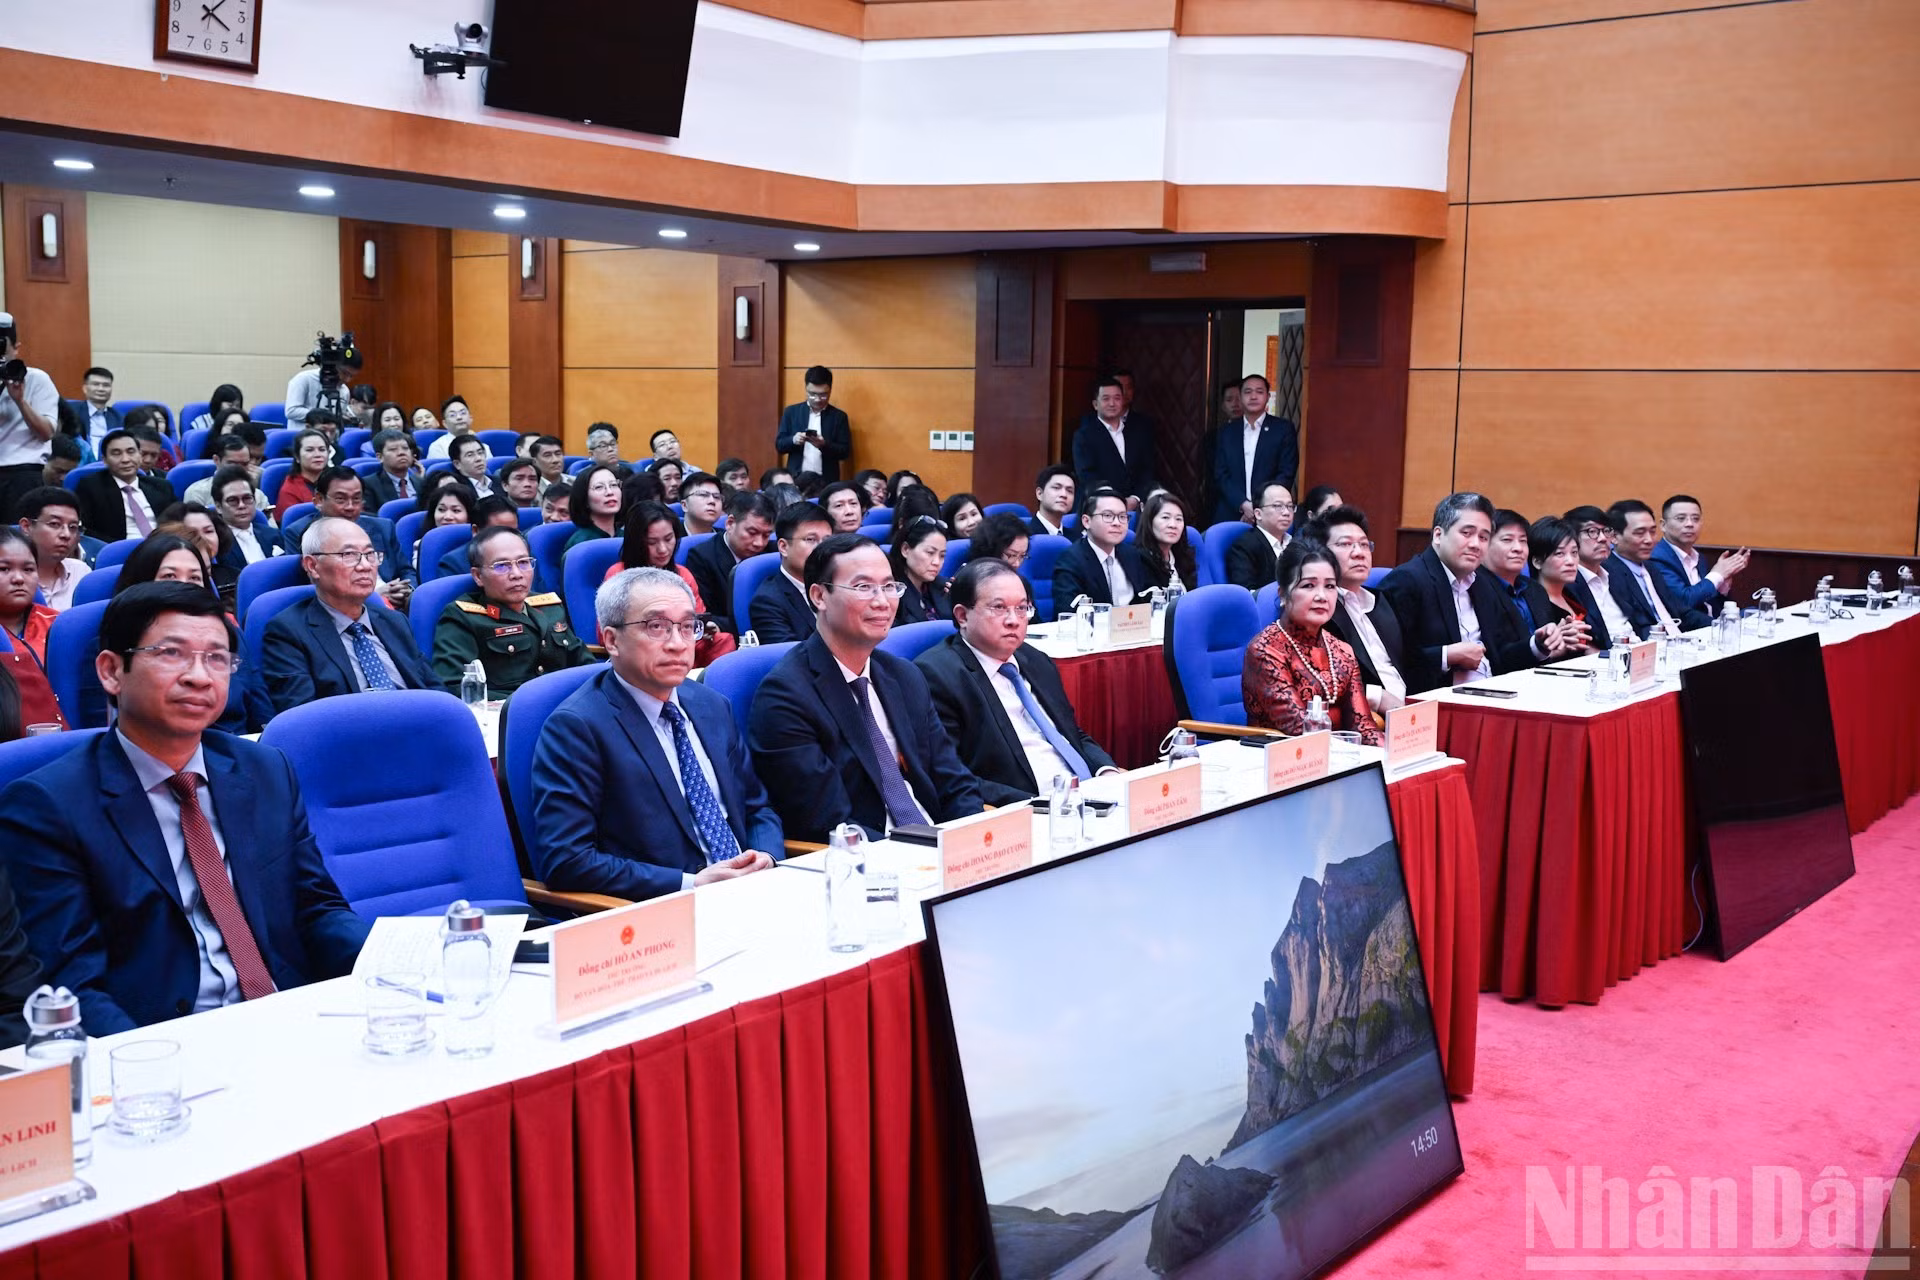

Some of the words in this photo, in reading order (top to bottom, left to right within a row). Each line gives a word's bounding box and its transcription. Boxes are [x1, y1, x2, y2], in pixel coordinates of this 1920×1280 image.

[238, 11, 246, 24] 3
[171, 20, 180, 33] 8
[187, 35, 195, 47] 7
[203, 38, 212, 51] 6
[236, 32, 244, 44] 4
[220, 41, 229, 53] 5
[578, 960, 600, 977] Đồng
[601, 957, 613, 970] chí
[630, 949, 643, 960] AN
[644, 940, 675, 956] PHONG
[17, 1120, 56, 1142] LINH
[1411, 1126, 1438, 1158] 14:50
